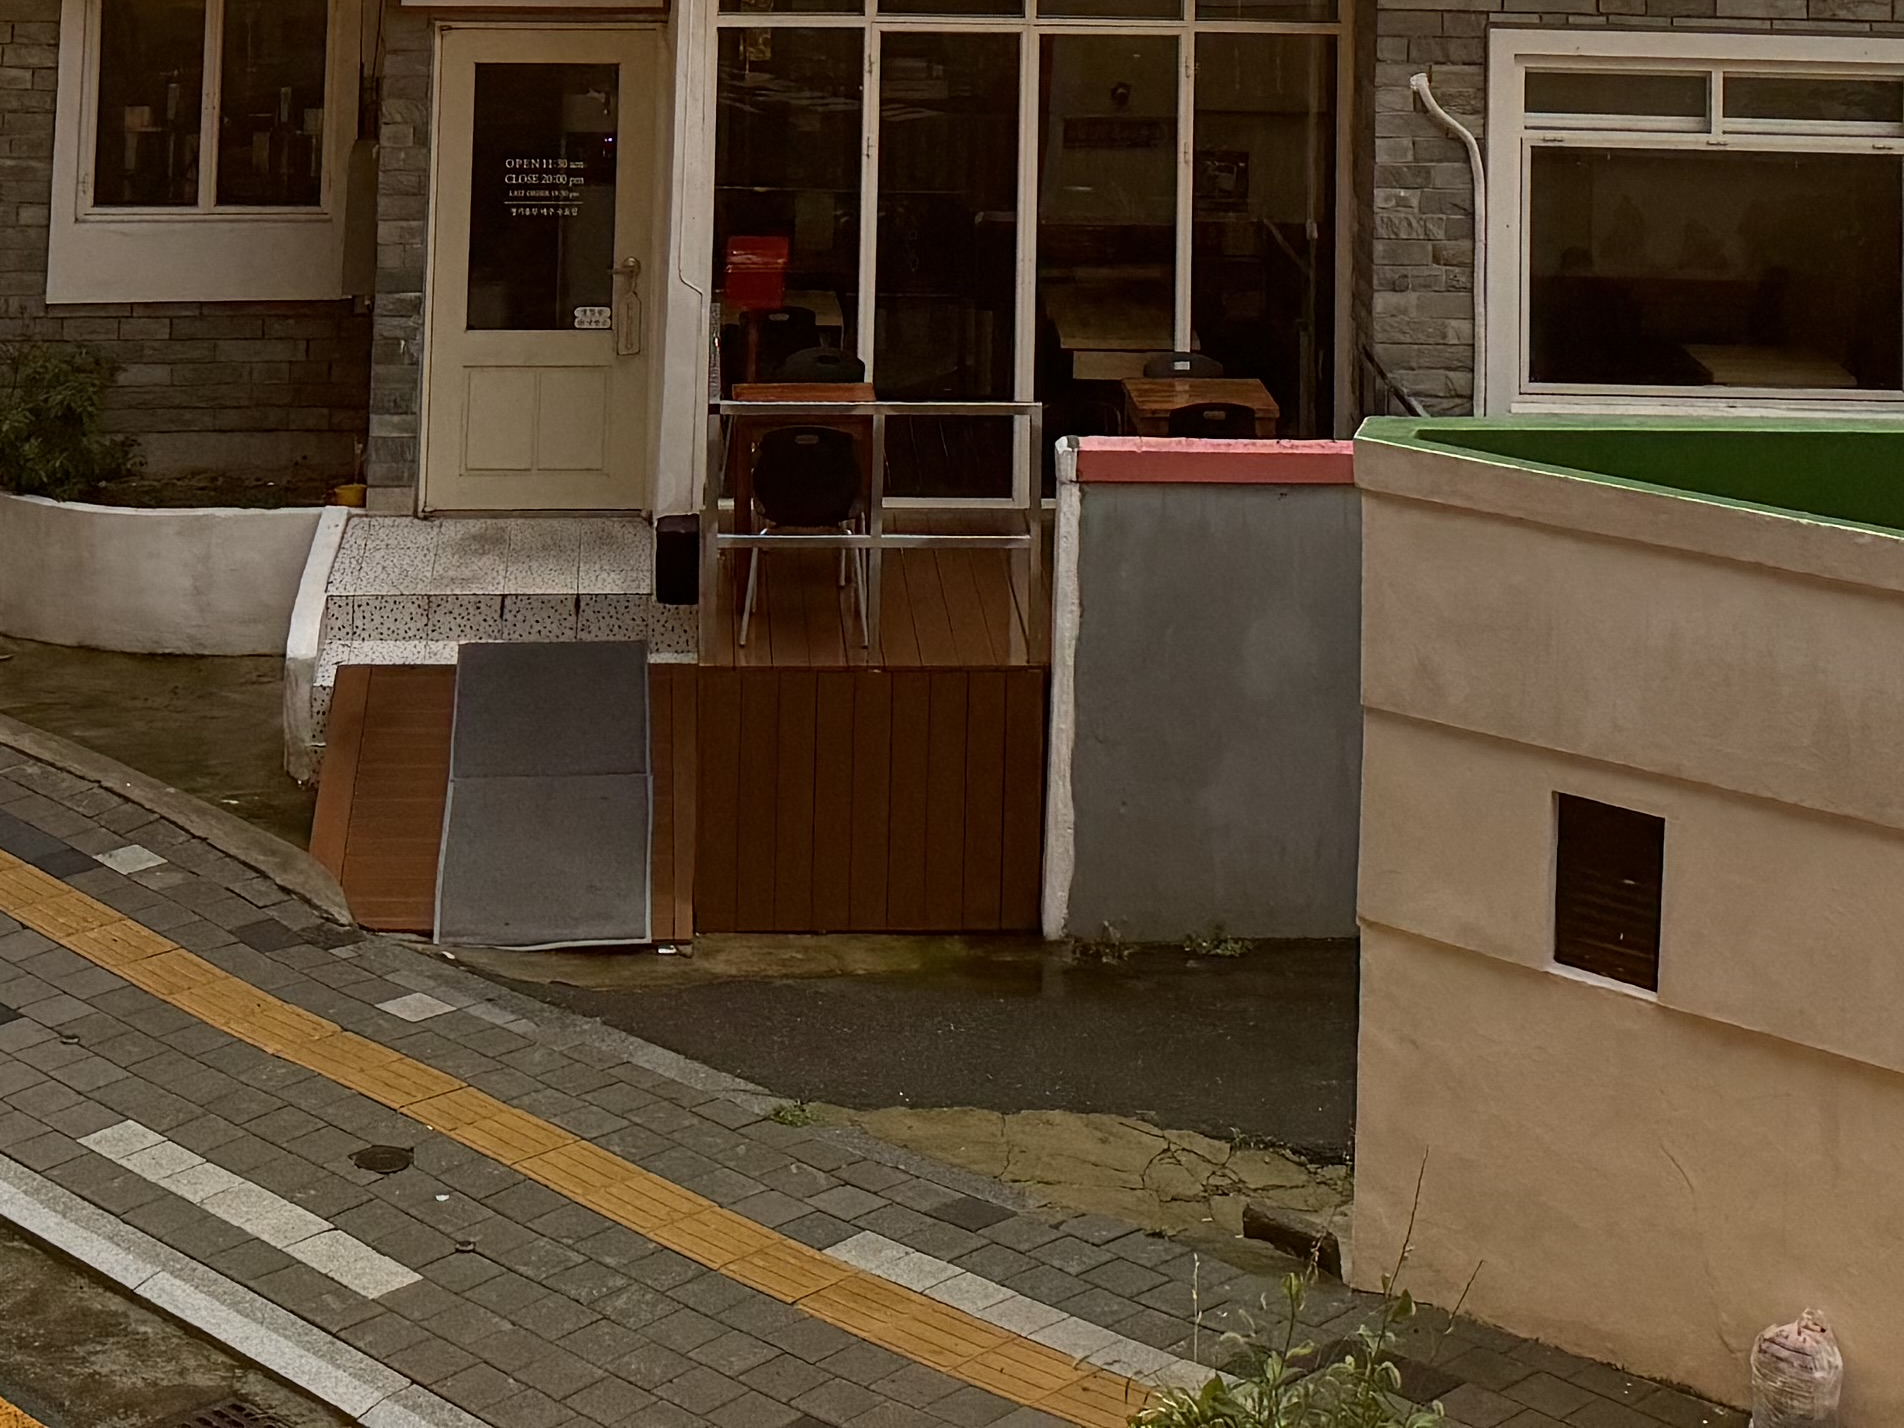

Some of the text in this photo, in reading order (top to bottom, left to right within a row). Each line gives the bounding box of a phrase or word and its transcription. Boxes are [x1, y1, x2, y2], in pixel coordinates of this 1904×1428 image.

[505, 158, 540, 169] OPEN
[542, 158, 568, 169] 11:30
[504, 173, 585, 187] CLOSE 20:00 pm
